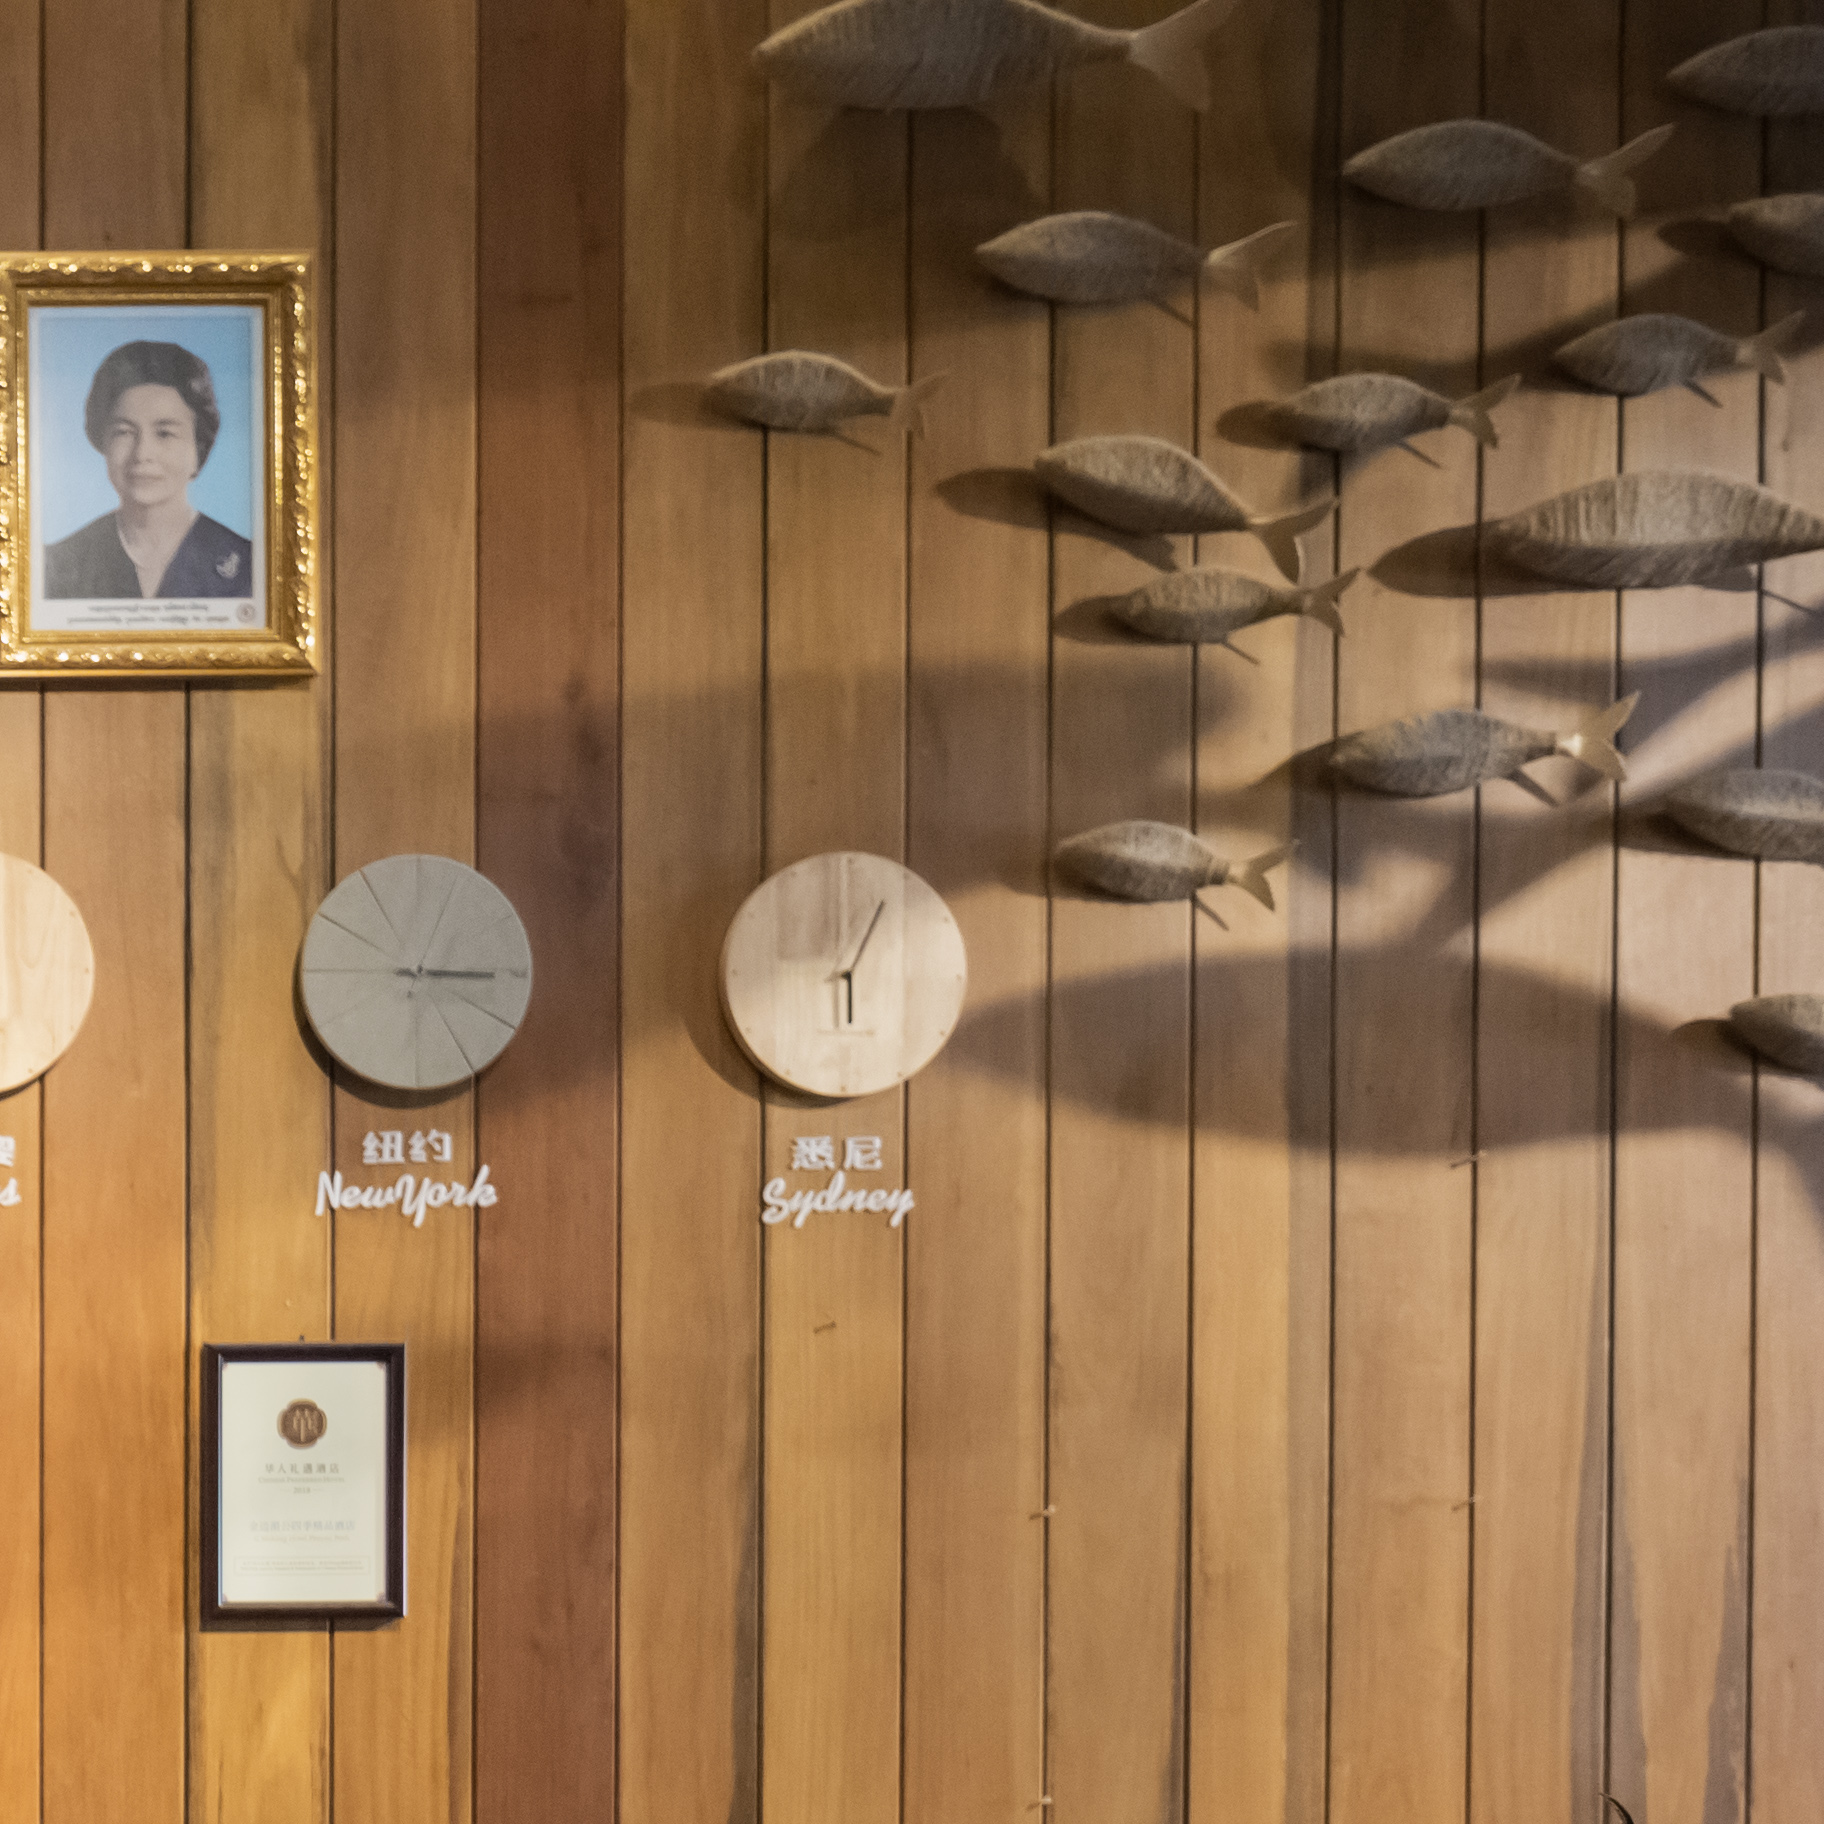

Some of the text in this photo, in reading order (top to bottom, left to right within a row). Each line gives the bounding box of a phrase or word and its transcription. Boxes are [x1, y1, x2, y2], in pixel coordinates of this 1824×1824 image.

[362, 1128, 452, 1165] 纽约
[789, 1135, 883, 1171] 悉尼
[761, 1170, 916, 1229] Sydney
